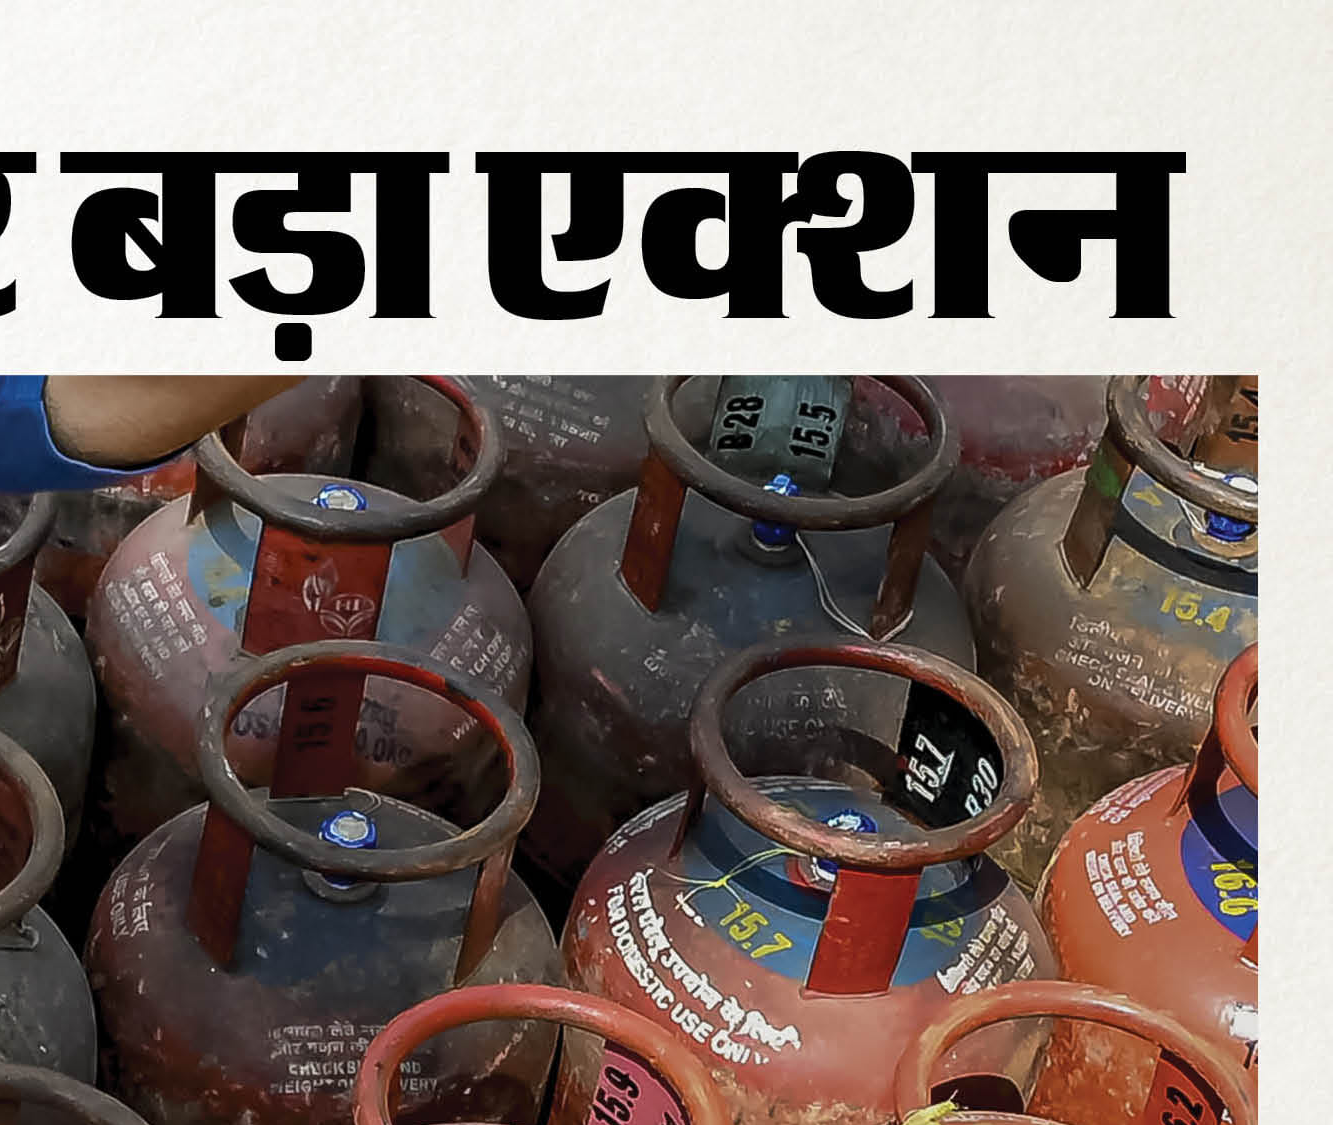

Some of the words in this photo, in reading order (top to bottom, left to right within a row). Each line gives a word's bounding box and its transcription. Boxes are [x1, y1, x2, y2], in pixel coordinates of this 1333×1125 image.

[787, 402, 838, 461] 15.5
[1159, 590, 1232, 634] 15.4
[903, 733, 957, 804] 15.7
[718, 900, 793, 960] 15.7
[610, 919, 675, 1010] DOMESTIC
[669, 1001, 714, 1044] USE
[398, 1061, 423, 1075] ND
[398, 1077, 439, 1092] VERY
